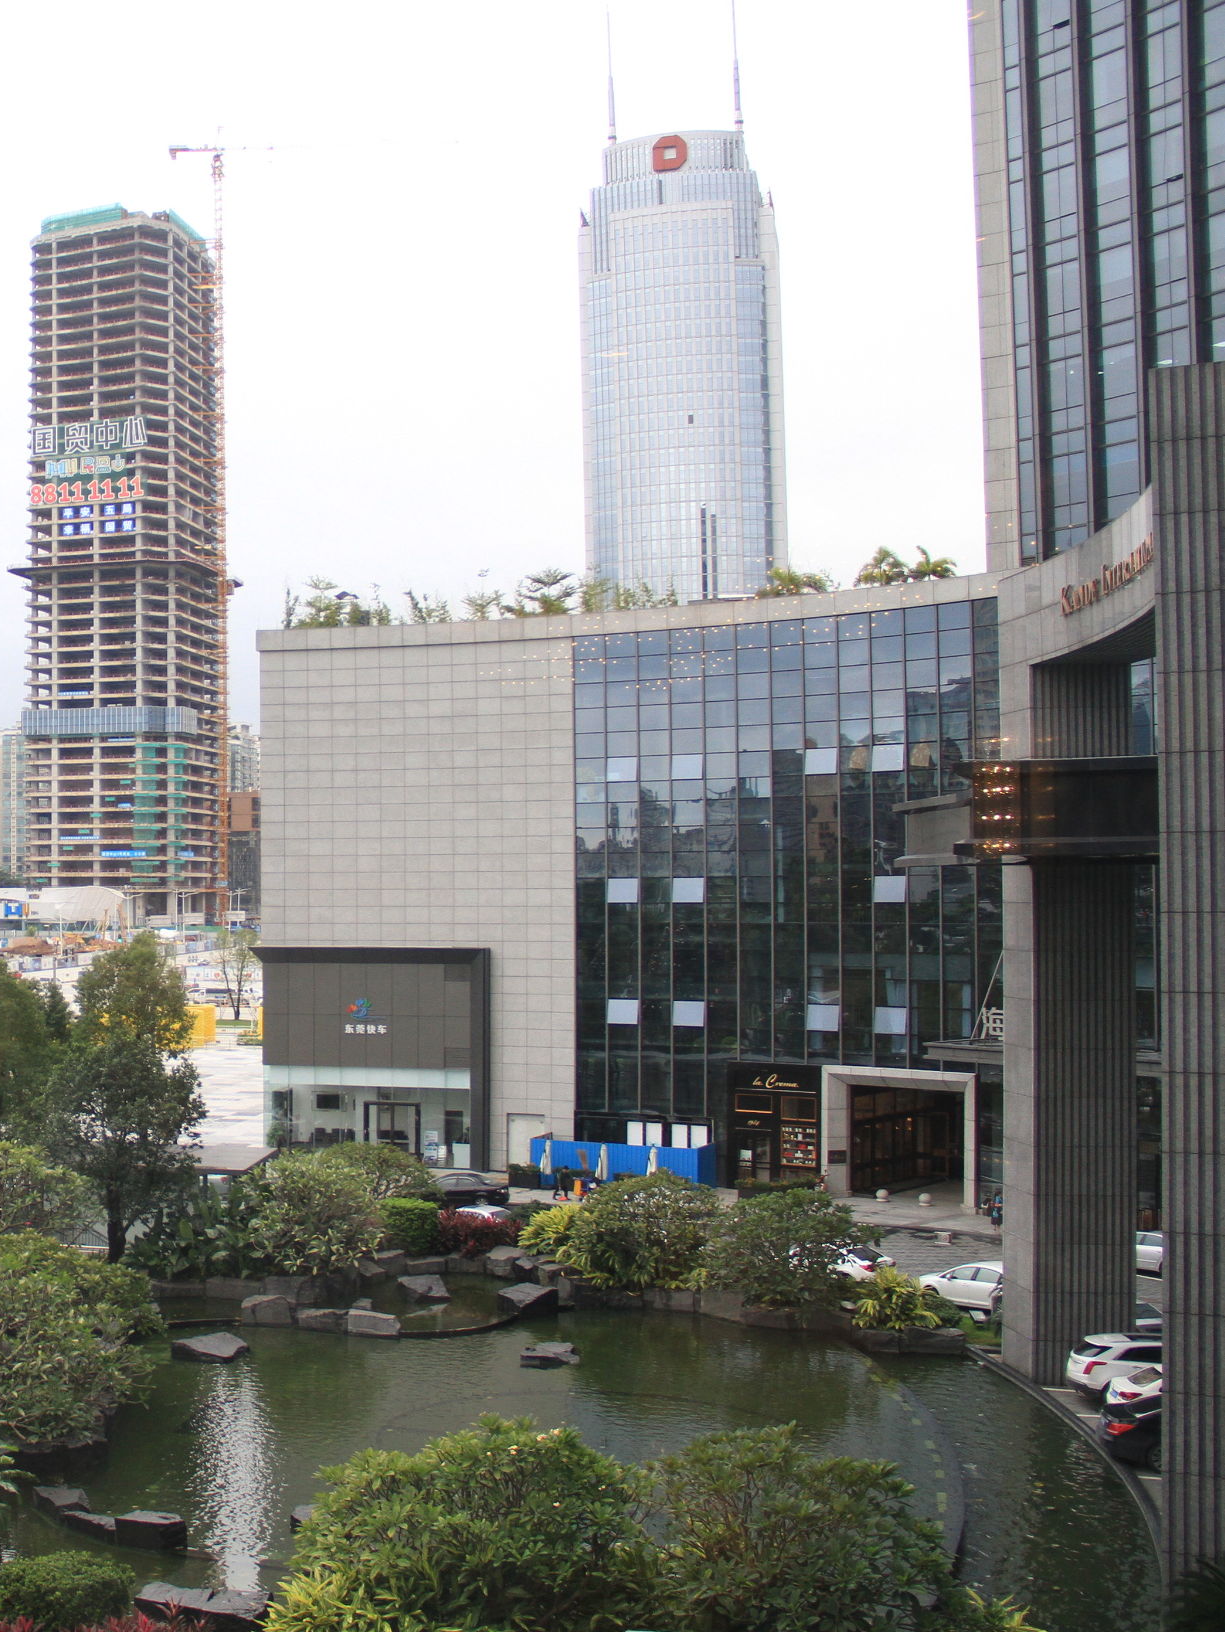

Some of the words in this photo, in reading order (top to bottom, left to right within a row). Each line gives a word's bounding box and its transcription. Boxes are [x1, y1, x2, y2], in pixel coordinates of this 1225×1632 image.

[32, 416, 148, 456] 国贸中心
[345, 1024, 387, 1034] 东莞快车
